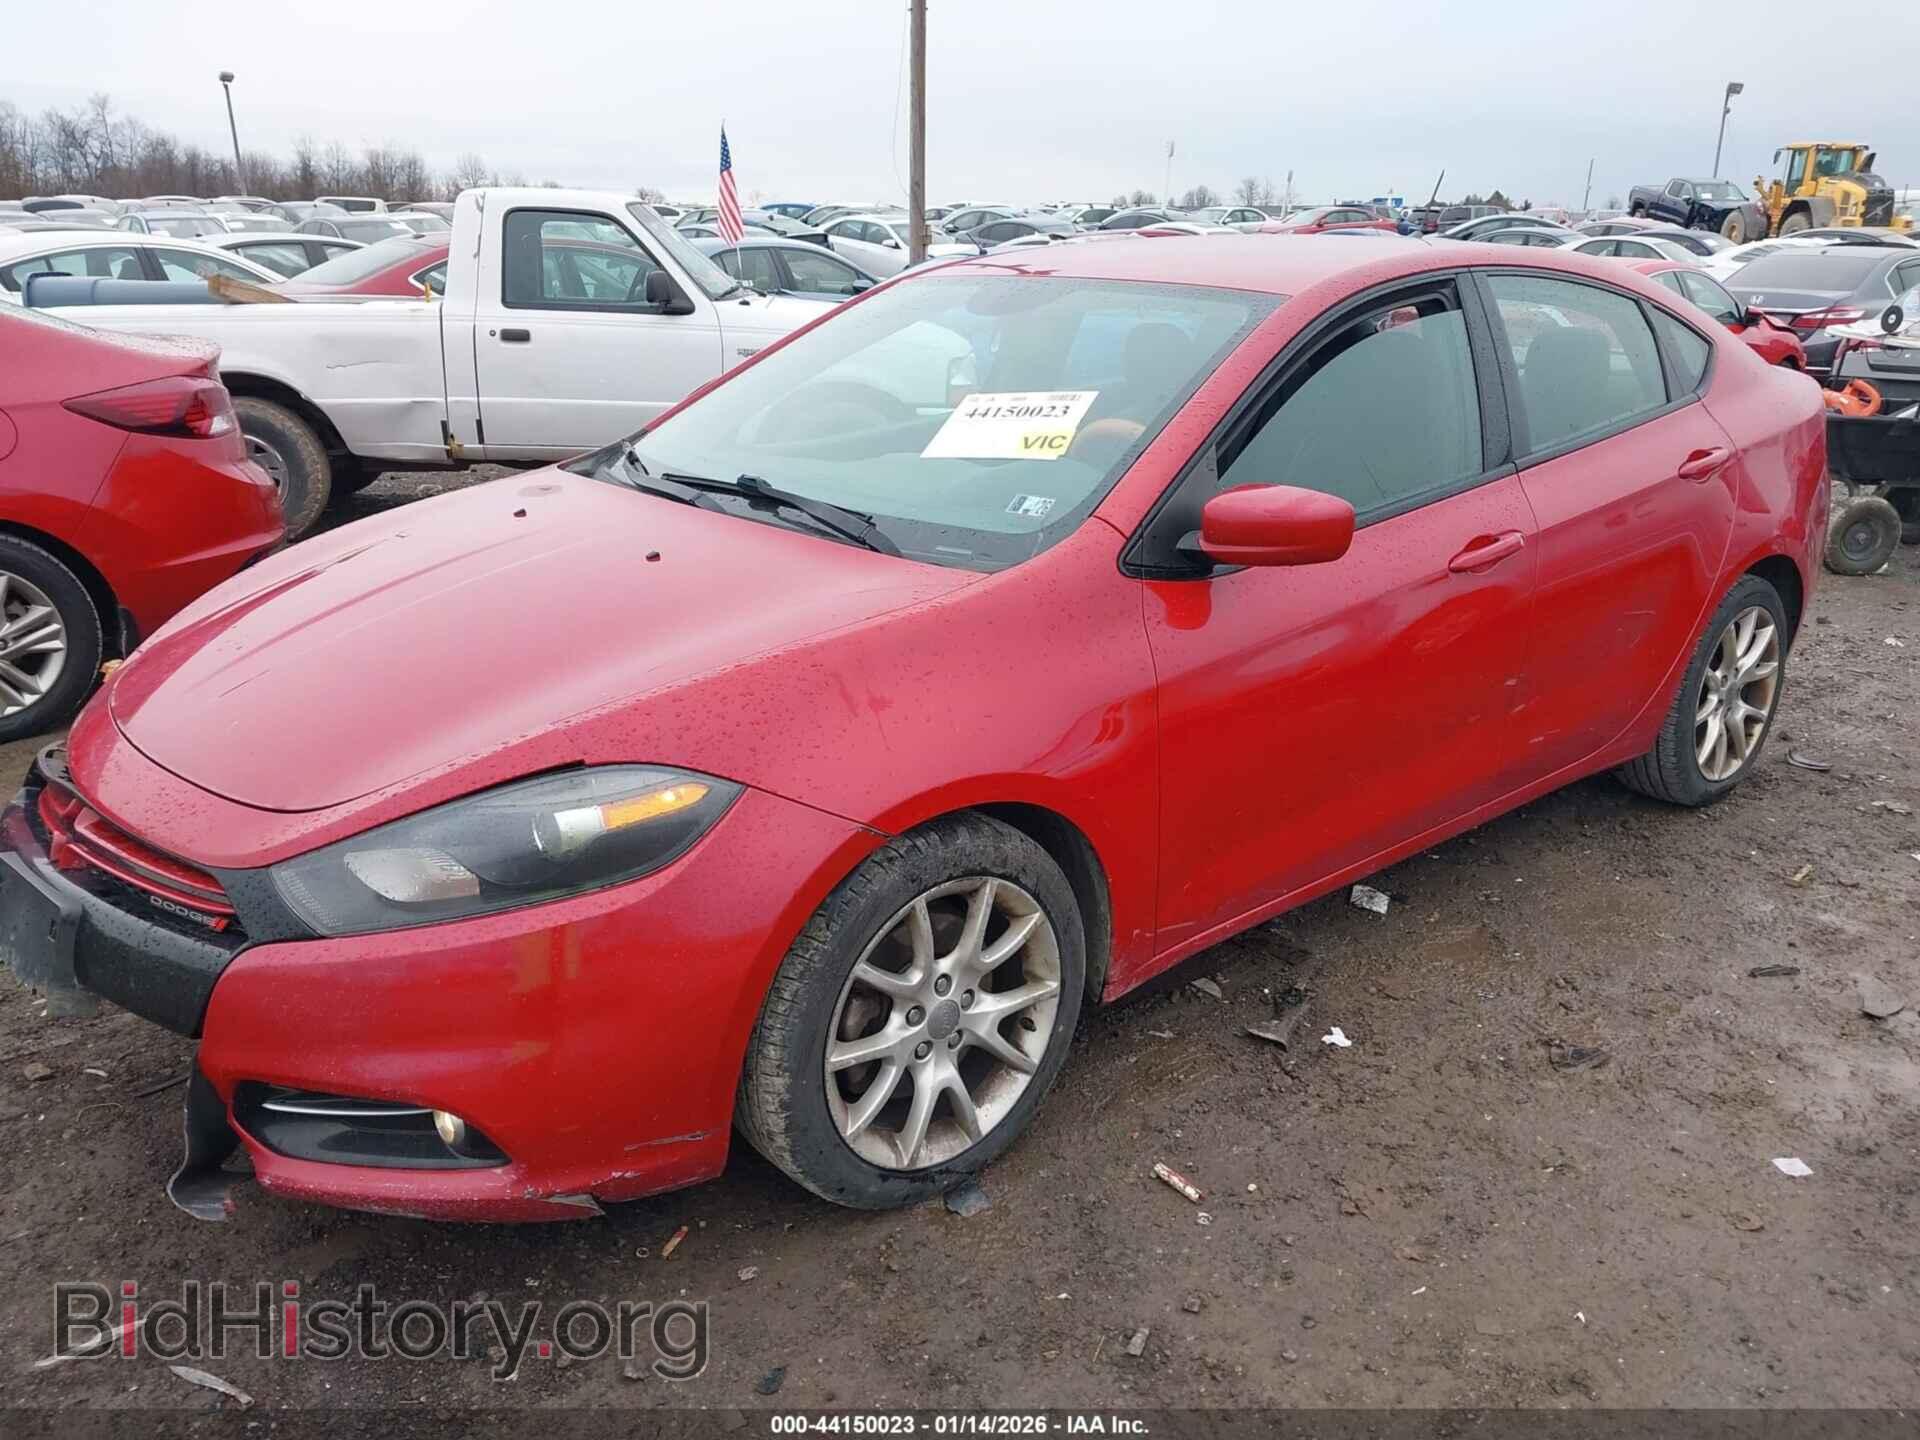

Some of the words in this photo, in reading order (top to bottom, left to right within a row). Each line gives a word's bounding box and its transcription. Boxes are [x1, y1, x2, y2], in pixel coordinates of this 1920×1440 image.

[966, 405, 1070, 419] 44150023
[1023, 434, 1067, 450] VIC
[150, 895, 217, 927] DODGE
